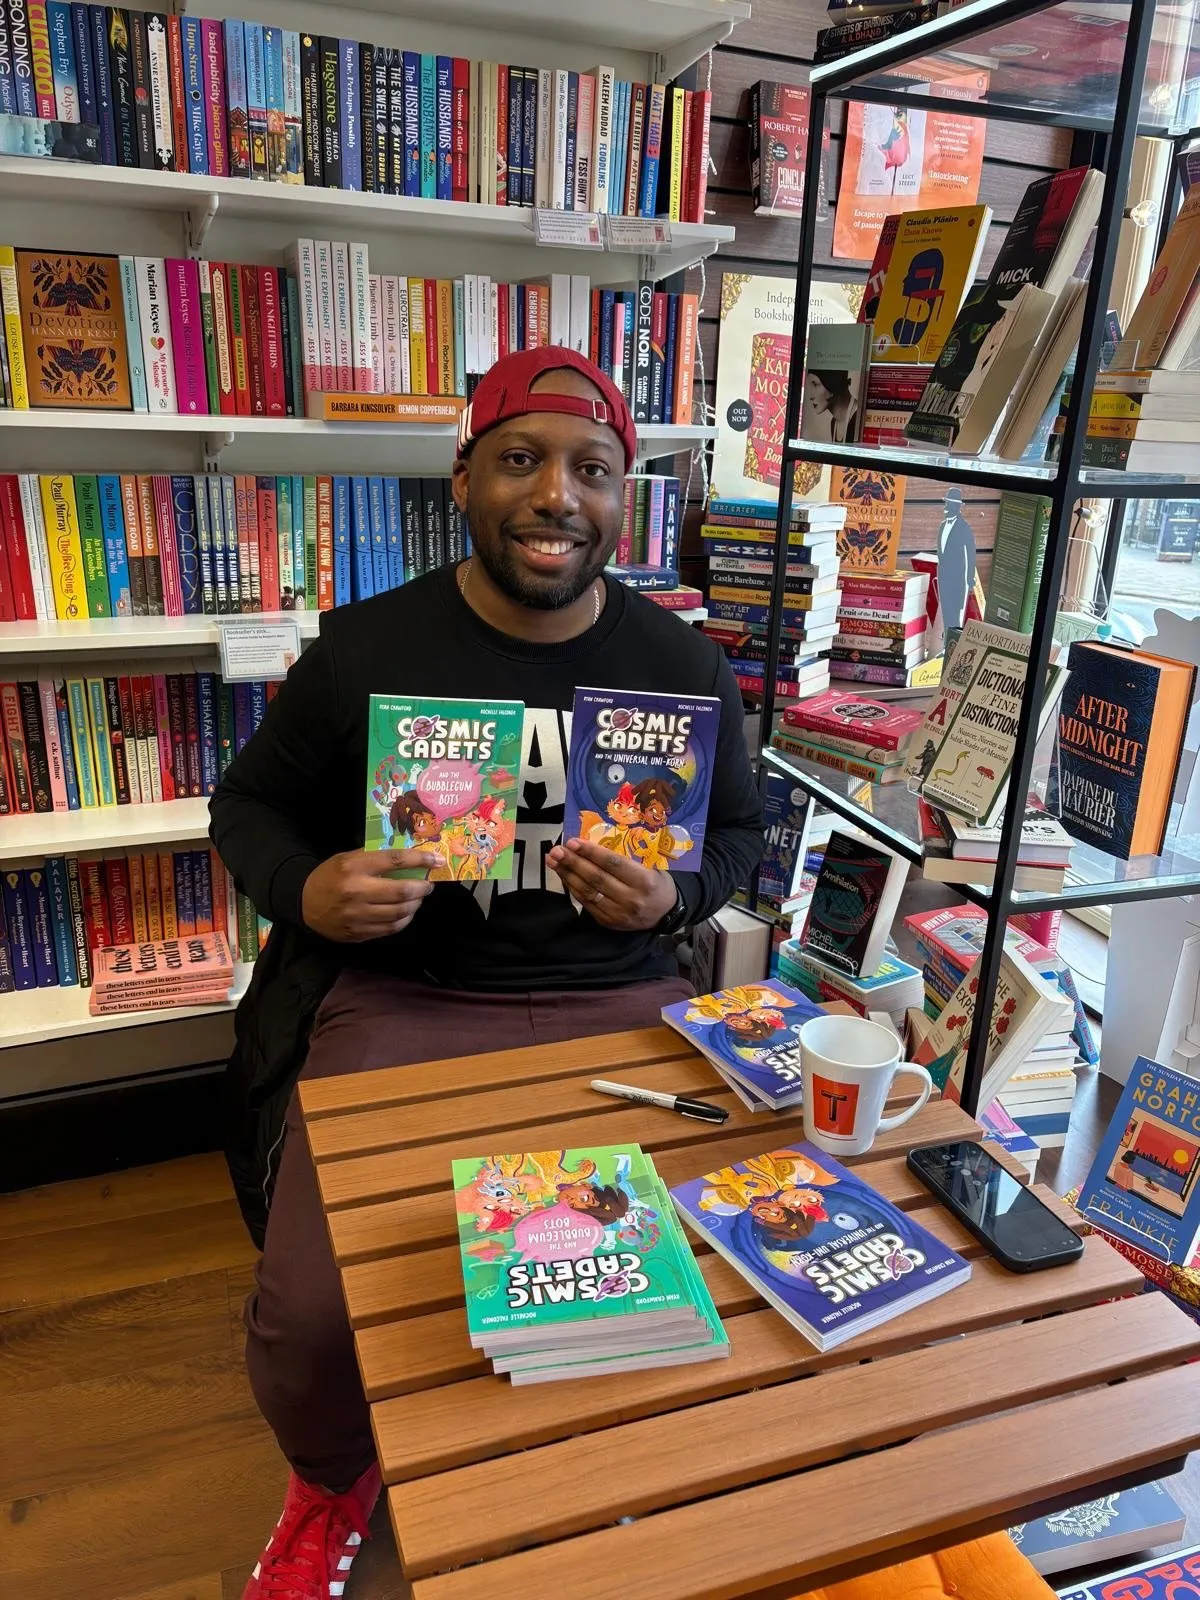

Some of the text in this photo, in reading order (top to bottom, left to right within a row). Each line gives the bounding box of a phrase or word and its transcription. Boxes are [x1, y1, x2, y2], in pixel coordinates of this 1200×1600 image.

[9, 0, 30, 78] BONDING
[54, 13, 69, 77] Stephen Fry
[188, 48, 198, 86] Street
[151, 51, 162, 130] ANNIE GARTHWAITE
[208, 32, 221, 139] bad publicity bianca
[322, 51, 337, 124] Hagstone
[375, 65, 387, 120] THE SWELL
[390, 67, 402, 122] THE SWELL
[41, 100, 50, 117] NELL
[405, 65, 418, 146] The HUSBANDS
[422, 67, 435, 150] The HUSBANDS
[649, 91, 661, 146] MATT HAIG
[598, 73, 610, 189] SALEEM HADDAD FLOODLINES
[764, 121, 795, 134] ROBERT
[378, 153, 386, 183] GORDON
[576, 156, 588, 205] TESS GUNTY
[778, 166, 805, 190] CONCLA
[629, 160, 642, 212] MATT HAIG
[854, 209, 875, 219] Escape
[906, 218, 932, 226] Claudia
[996, 267, 1034, 285] MICK
[146, 263, 161, 334] Marian Keyes
[178, 265, 189, 324] marian keyes
[305, 280, 314, 329] EXPERIMENT
[357, 283, 366, 333] EXPERIMENT
[29, 312, 119, 330] Devotion
[400, 289, 408, 339] EUROTRASH
[637, 285, 651, 367] CODE NOIR
[30, 328, 119, 338] HANNAH KENT
[765, 358, 790, 376] KAT
[755, 377, 788, 398] MOS
[331, 402, 456, 416] BARBARA KINGSOLVER DEMON COPPERHEAD
[731, 415, 748, 423] NOW
[53, 482, 67, 532] Paul Murray
[82, 482, 95, 532] Paul Murray
[125, 498, 135, 526] COAST
[405, 510, 413, 528] Time
[427, 510, 435, 527] Time
[873, 513, 896, 522] KENT
[129, 527, 138, 552] ROAD
[319, 482, 330, 569] ONLY ONLY NOW
[666, 494, 676, 570] HAMNE
[294, 529, 304, 570] Sandwich
[713, 574, 765, 585] Castle Barebane
[716, 603, 750, 613] DON'T LET
[839, 608, 890, 620] Fruit Dead
[967, 627, 982, 638] IAN
[977, 668, 1026, 699] DICTIONA
[4, 694, 20, 733] FIGHT
[200, 677, 213, 737] ELIF SHAFAK
[990, 697, 1017, 713] FINE
[1075, 693, 1128, 733] AFTER
[397, 715, 496, 741] COSMIC
[598, 708, 692, 735] COSMIC
[398, 739, 492, 760] CADETS
[597, 730, 686, 753] CADETS
[1060, 713, 1143, 767] MIDNIGHT
[614, 754, 648, 765] UNIVERSAL
[651, 757, 685, 768] UNI-KORN
[426, 781, 473, 792] BUBBLEGUM
[439, 794, 458, 805] BOTS
[1063, 770, 1119, 808] DAPHNE DU
[51, 859, 65, 920] PALAVER
[822, 868, 859, 894] Annihilation
[921, 910, 954, 931] HUNTING
[74, 914, 88, 979] rebecca watson
[807, 928, 834, 946] MICHEL
[106, 979, 143, 990] these letters
[1146, 1063, 1182, 1083] THE SUNDAY
[820, 1090, 847, 1121] T
[1139, 1073, 1200, 1109] GRAH
[1132, 1087, 1200, 1131] NORTO
[528, 1228, 590, 1243] BUBBLEGUM
[543, 1217, 570, 1228] BOTS
[549, 1242, 560, 1250] THE
[829, 1229, 865, 1250] UNIVERSAL
[508, 1253, 642, 1287] CADETS
[805, 1233, 905, 1285] CADETS
[1123, 1247, 1173, 1280] MOSSE
[507, 1270, 649, 1308] COSMIC
[819, 1248, 926, 1303] COSMIC
